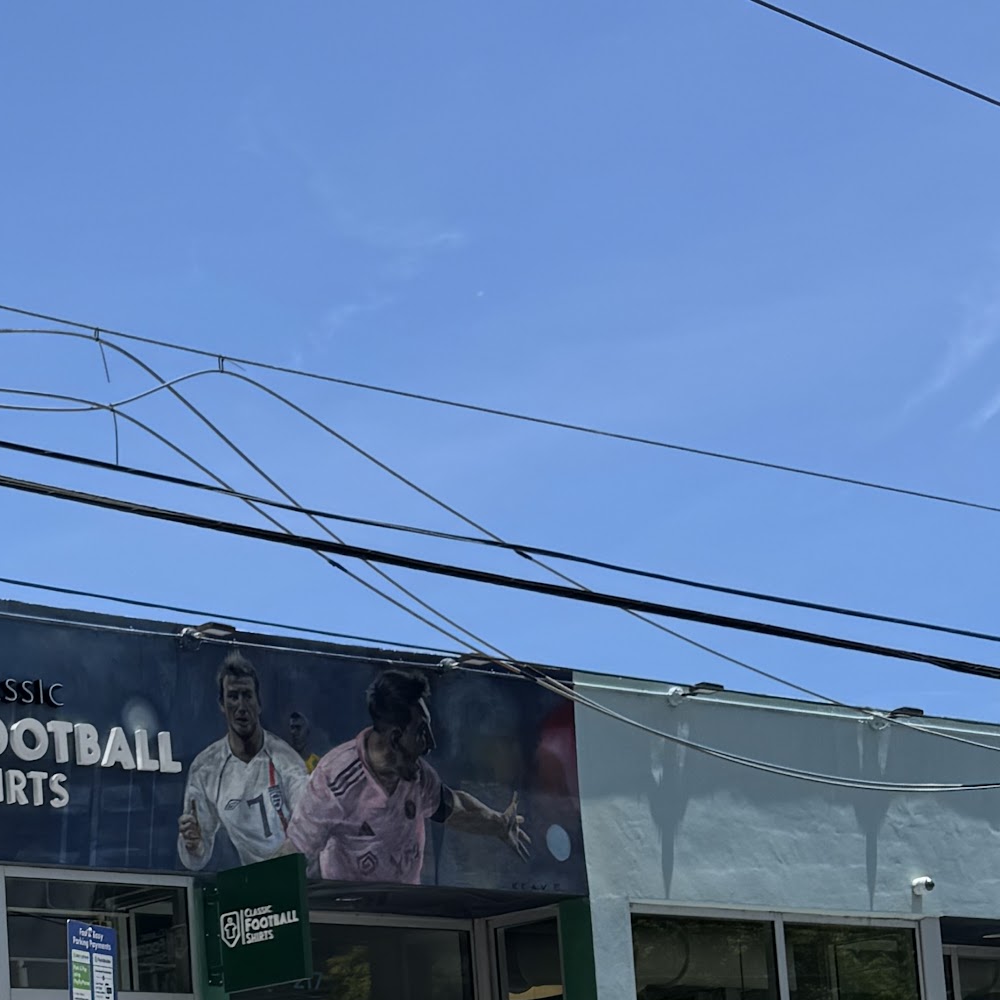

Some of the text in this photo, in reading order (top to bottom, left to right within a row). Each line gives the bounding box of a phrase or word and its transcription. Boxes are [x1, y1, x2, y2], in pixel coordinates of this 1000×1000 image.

[246, 793, 273, 839] 7
[244, 904, 274, 918] CLASSIC
[244, 909, 300, 933] FOOTBALL
[72, 935, 112, 951] Parking Payments
[245, 929, 275, 945] SHIRTS
